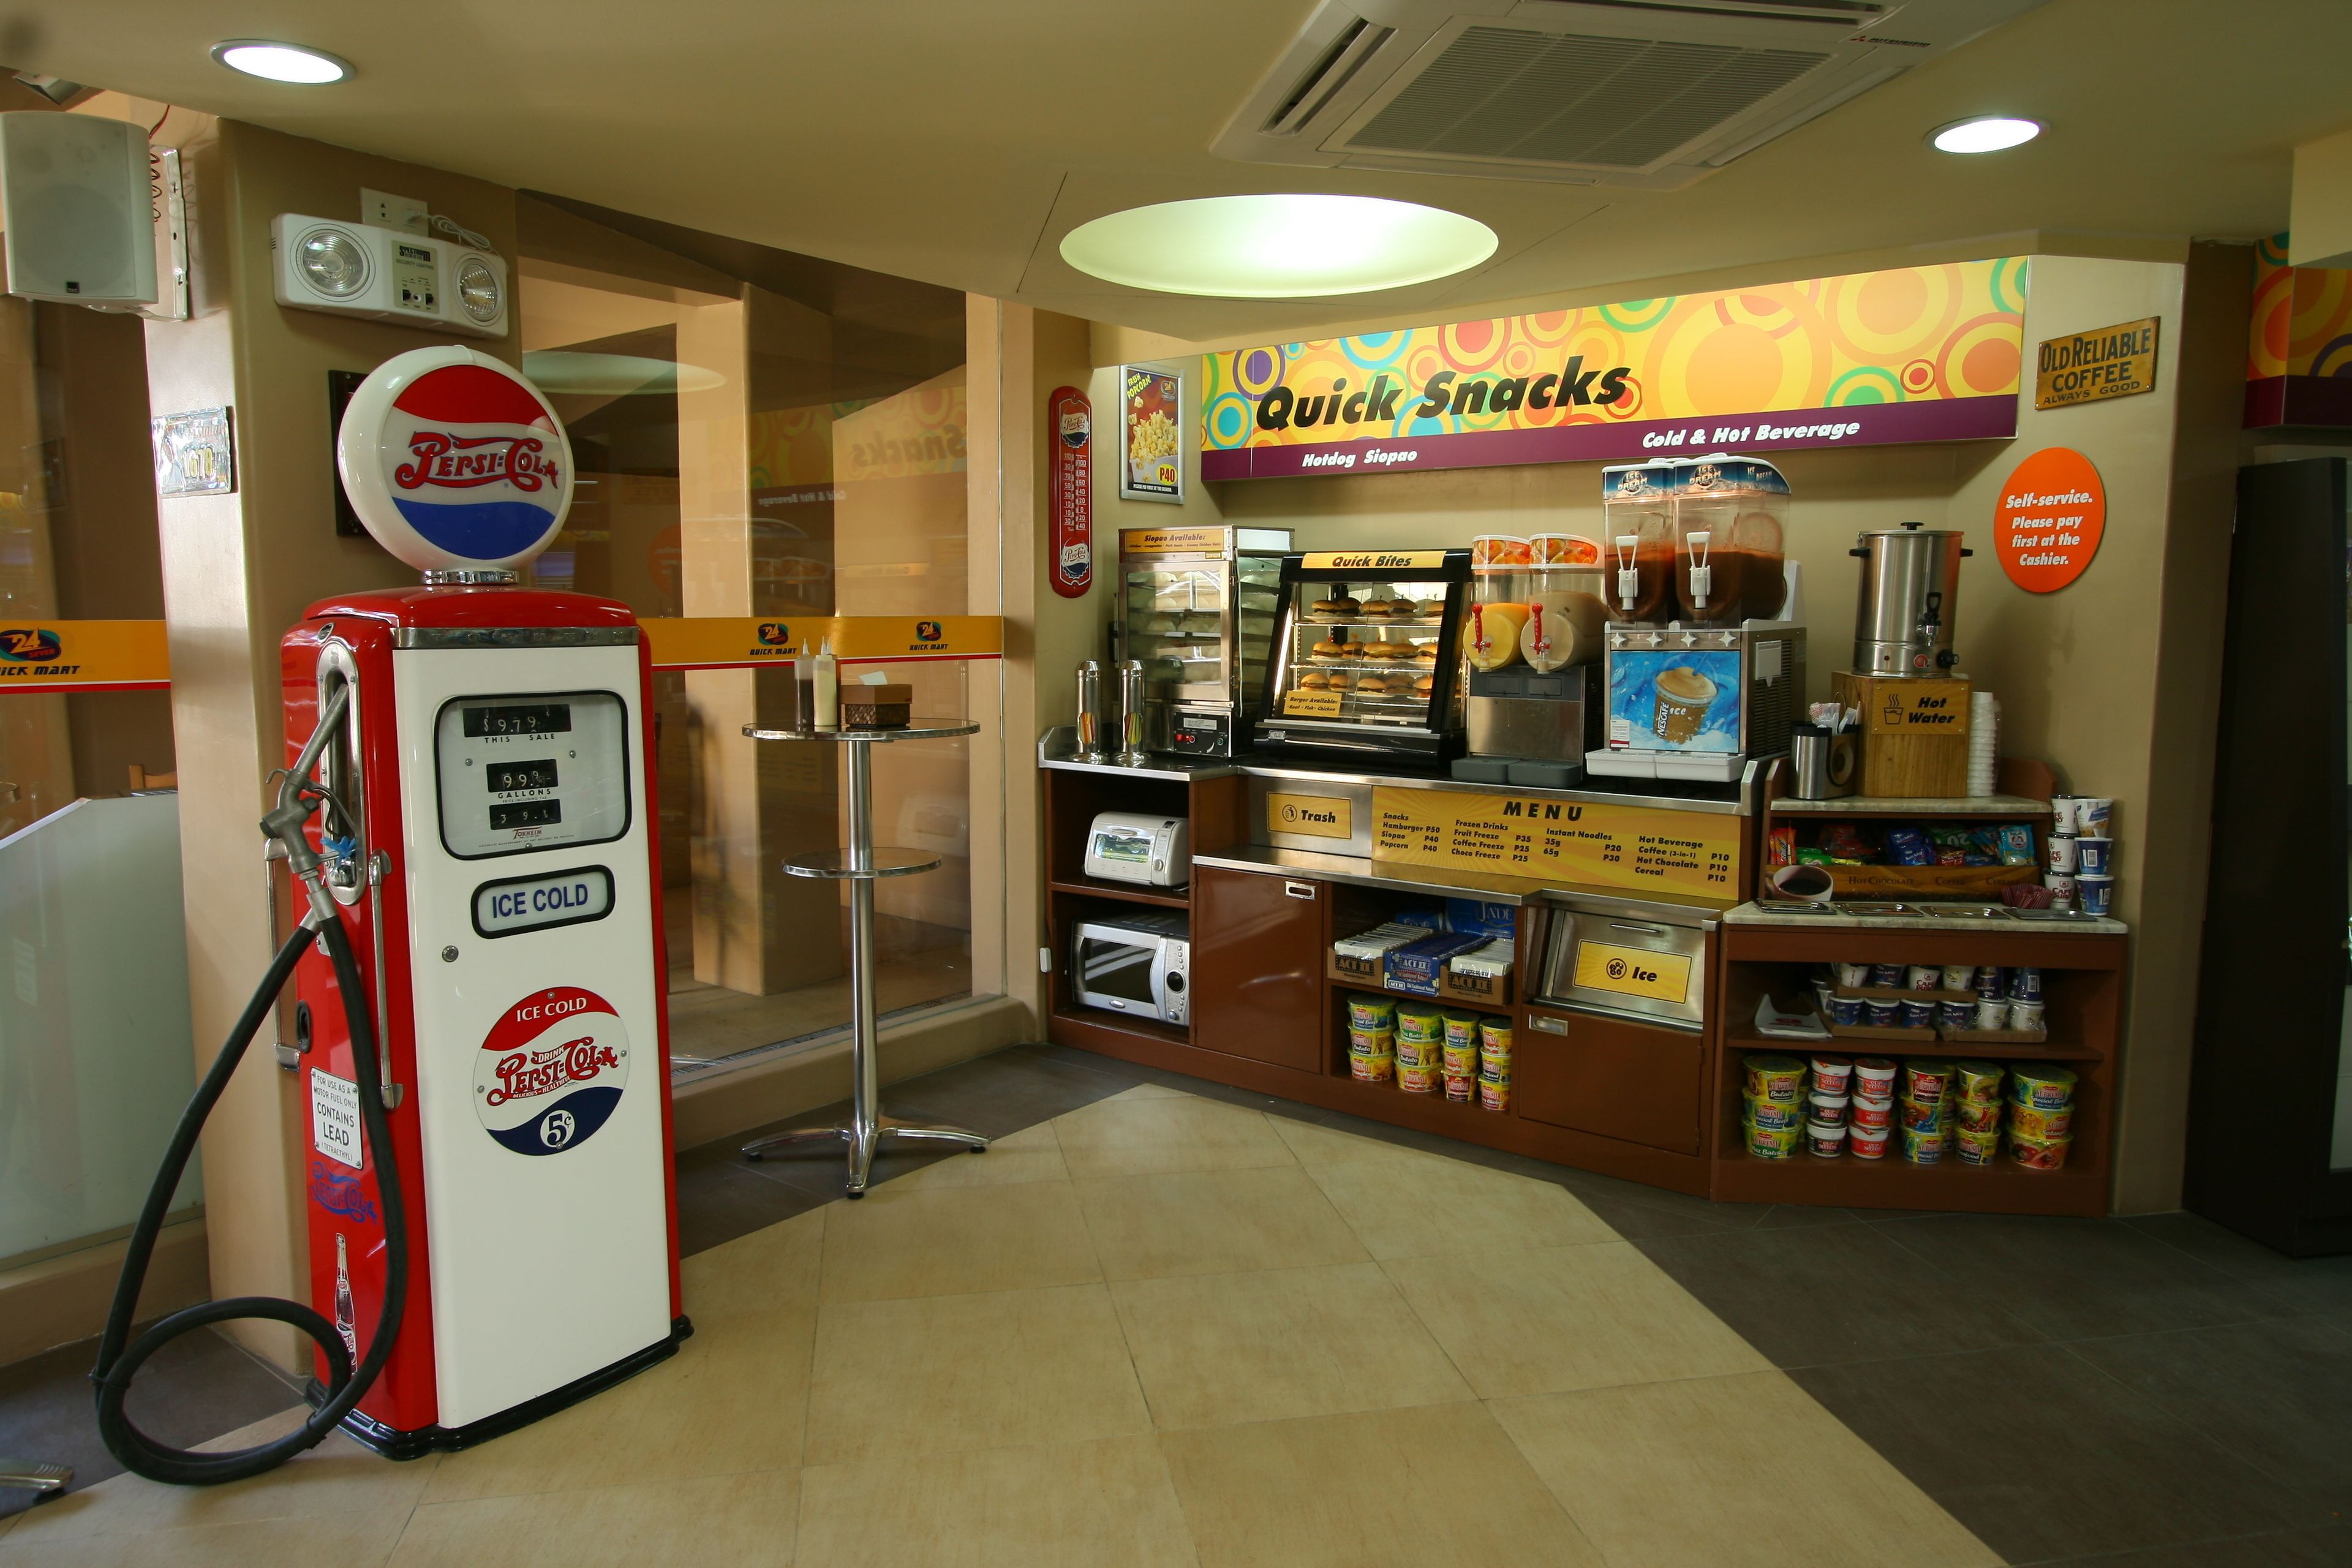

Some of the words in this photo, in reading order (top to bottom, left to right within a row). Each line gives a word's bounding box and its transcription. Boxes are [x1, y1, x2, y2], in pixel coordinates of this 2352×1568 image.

[2041, 342, 2070, 373] OLD
[2071, 328, 2151, 368] RELIABLE
[2052, 360, 2132, 393] COFFEE
[1255, 376, 1408, 431] Quick
[1416, 356, 1631, 419] Snacks
[2043, 389, 2090, 404] ALWAYS
[2100, 381, 2140, 395] GOOD
[1643, 429, 1685, 448] Cold
[1689, 429, 1706, 445] &
[1713, 427, 1750, 443] Hot
[1755, 421, 1860, 442] Beverage
[1302, 453, 1355, 468] Hotdog
[1365, 449, 1417, 466] Siopao
[1159, 467, 1175, 482] P40
[1626, 471, 1640, 480] ICE
[1698, 465, 1714, 473] ICE
[2005, 489, 2093, 509] Self-service.
[2011, 516, 2052, 529] Please
[2056, 516, 2083, 531] pay
[2012, 535, 2037, 547] first
[2041, 535, 2054, 546] at
[2058, 533, 2079, 546] the
[1332, 556, 1371, 567] Quick
[1375, 555, 1412, 567] Bites
[2019, 554, 2068, 565] Cashier.
[0, 667, 28, 676] ICK
[34, 666, 80, 674] MART
[1917, 697, 1947, 709] Hot
[1909, 711, 1955, 724] Water
[498, 789, 551, 799] GALLONS
[1301, 810, 1336, 823] Trash
[1503, 801, 1582, 821] MENU
[512, 826, 542, 839] TOKHEIM
[1382, 822, 1423, 832] Hamburger
[1547, 828, 1575, 837] Instant
[1578, 831, 1612, 840] Noodles
[1380, 840, 1408, 850] Popcorn
[1453, 839, 1476, 848] Coffee
[1545, 838, 1561, 847] 35g
[1658, 837, 1703, 848] Beverage
[1476, 851, 1500, 859] Freeze
[1544, 848, 1559, 858] 65g
[1638, 846, 1667, 855] Coffee
[1670, 850, 1696, 859] (3-in-1)
[1655, 859, 1698, 869] Chocolate
[1635, 867, 1664, 876] Cereal
[492, 892, 526, 918] ICE
[533, 884, 588, 911] COLD
[1632, 967, 1657, 982] Ice
[516, 1006, 540, 1022] ICE
[545, 997, 587, 1016] COLD
[538, 1046, 565, 1063] DRINK
[317, 1075, 326, 1086] FOR
[328, 1079, 337, 1090] USE
[338, 1084, 345, 1093] AS
[542, 1076, 570, 1093] HEALTHFUL
[314, 1086, 329, 1099] MOTOR
[330, 1092, 342, 1104] FUEL
[344, 1098, 357, 1109] ONLY
[317, 1102, 355, 1128] CONTAINS
[323, 1121, 349, 1147] LEAD
